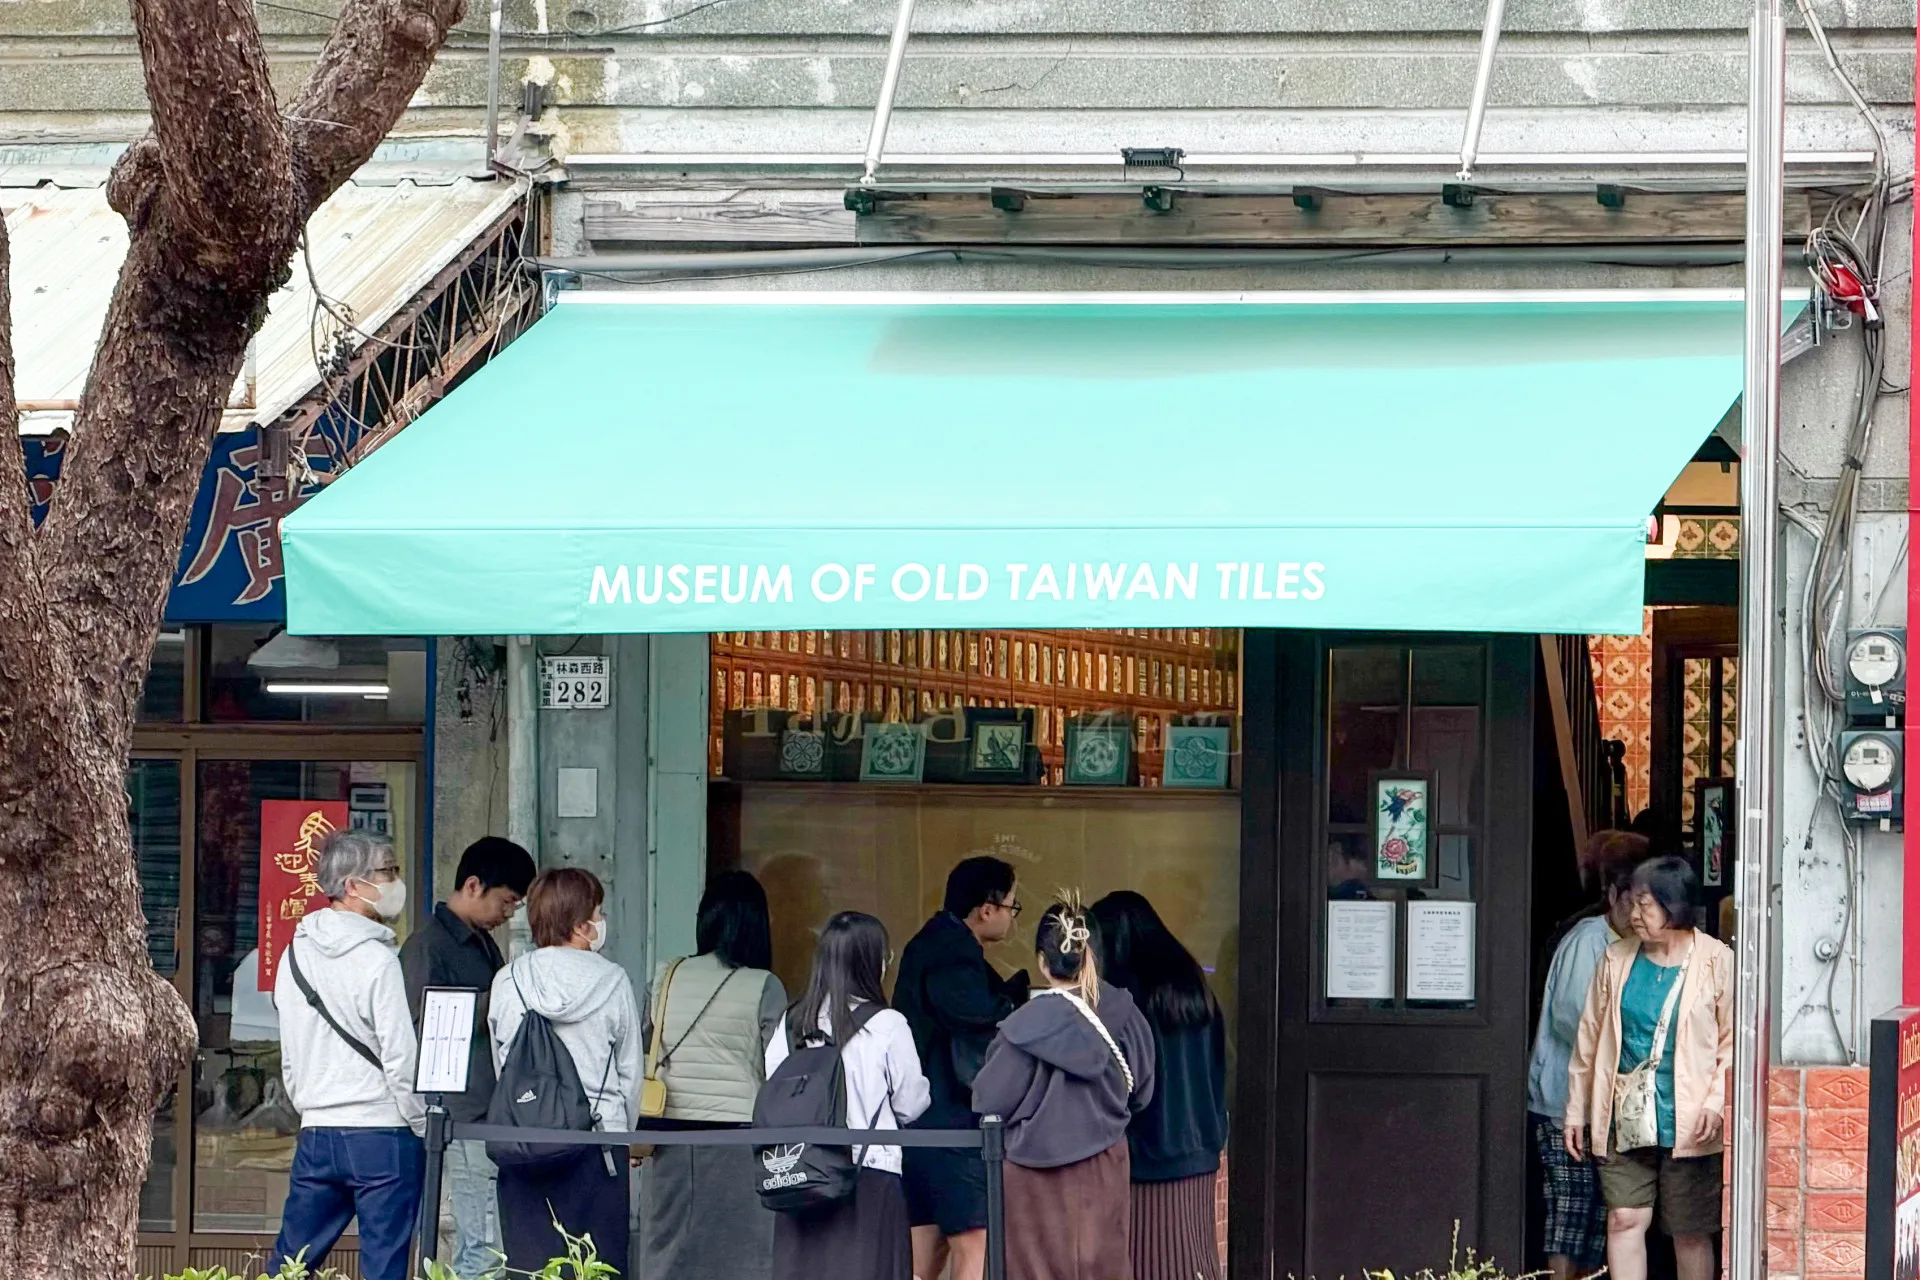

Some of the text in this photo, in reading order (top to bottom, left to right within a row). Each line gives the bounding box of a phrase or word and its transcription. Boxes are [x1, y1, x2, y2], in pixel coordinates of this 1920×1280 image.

[588, 561, 1326, 604] MUSEUM OF OLD TAIWAN TILES
[557, 662, 604, 675] 林森西路
[558, 681, 602, 703] 282
[763, 1172, 808, 1190] adidas
